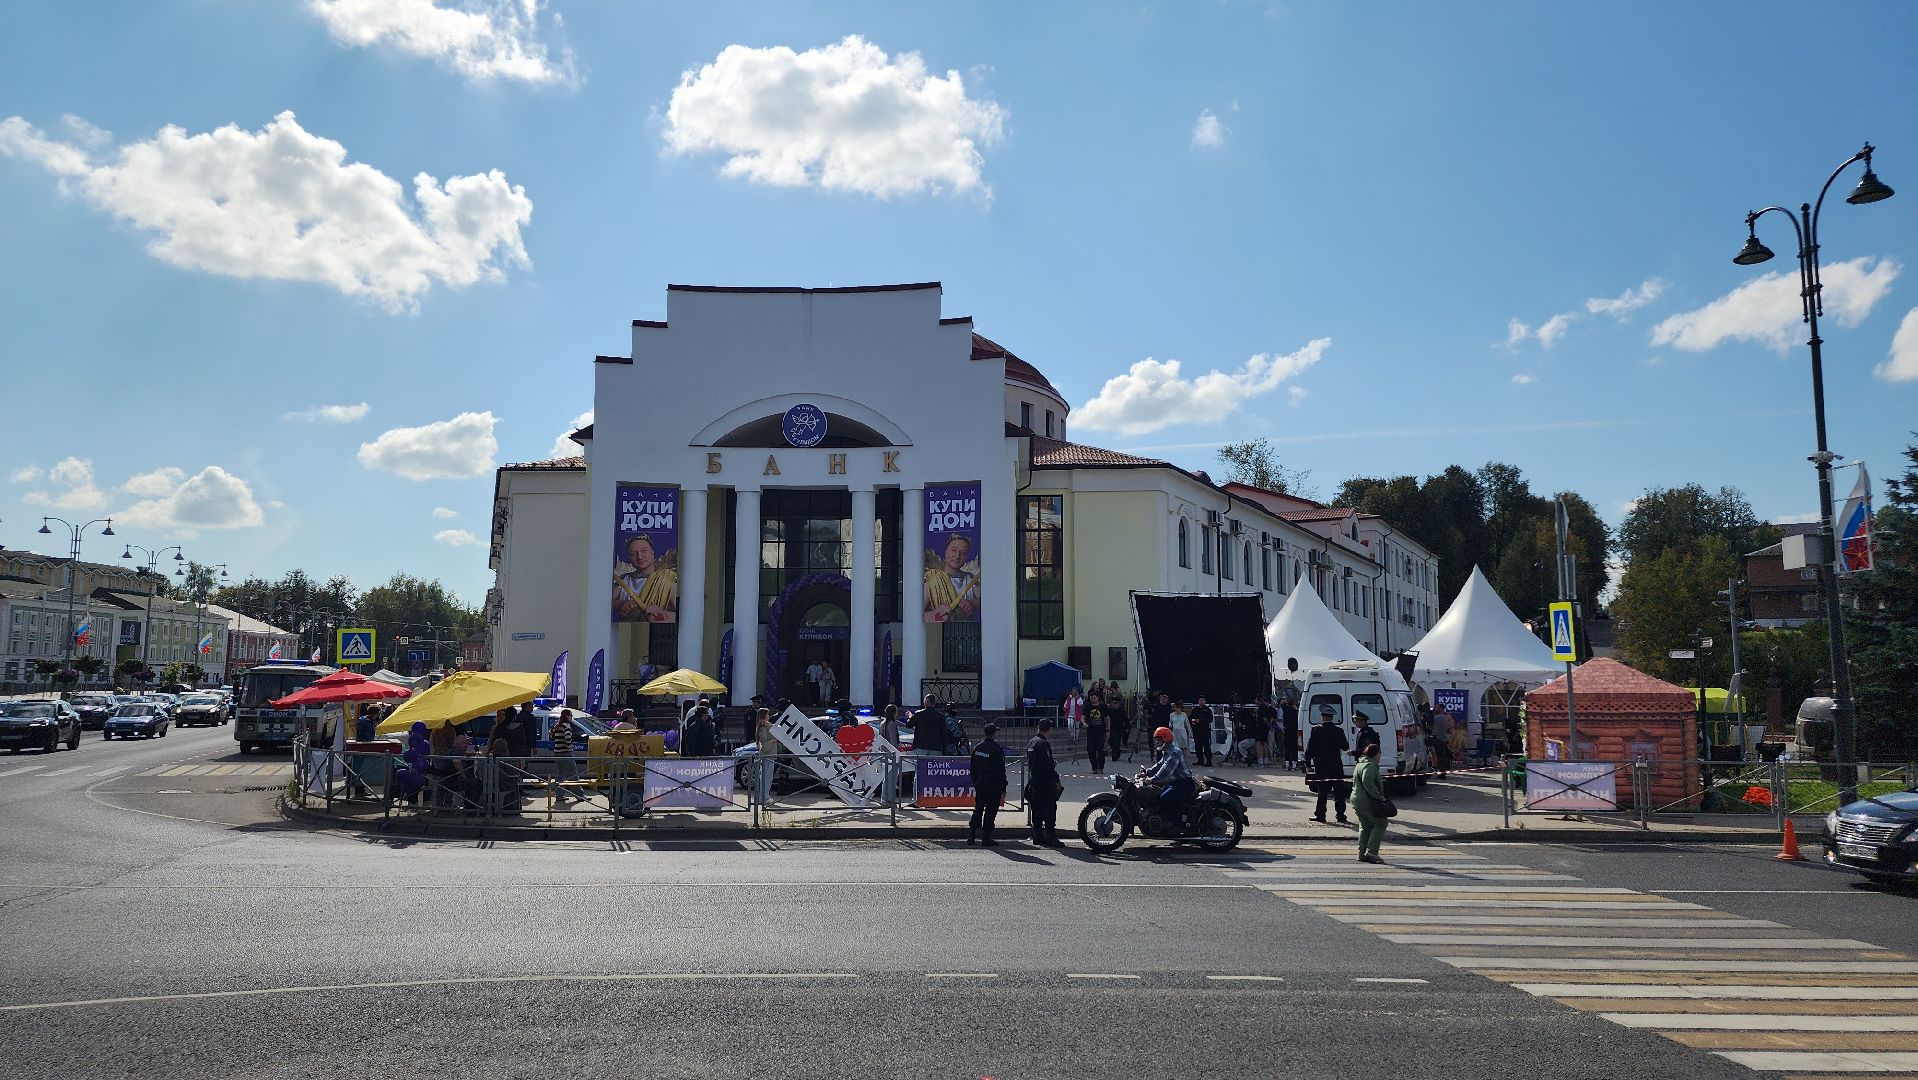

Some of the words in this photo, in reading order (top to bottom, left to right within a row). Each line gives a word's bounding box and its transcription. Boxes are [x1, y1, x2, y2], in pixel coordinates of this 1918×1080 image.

[706, 451, 900, 475] БАНК
[622, 500, 674, 514] КУПИ
[929, 498, 976, 514] КУПИ
[620, 513, 673, 531] ДОМ
[928, 511, 976, 532] ДОМ
[1438, 696, 1464, 704] КУПИ
[927, 761, 951, 769] БАНК
[923, 786, 955, 798] НАМ
[957, 786, 965, 798] 7
